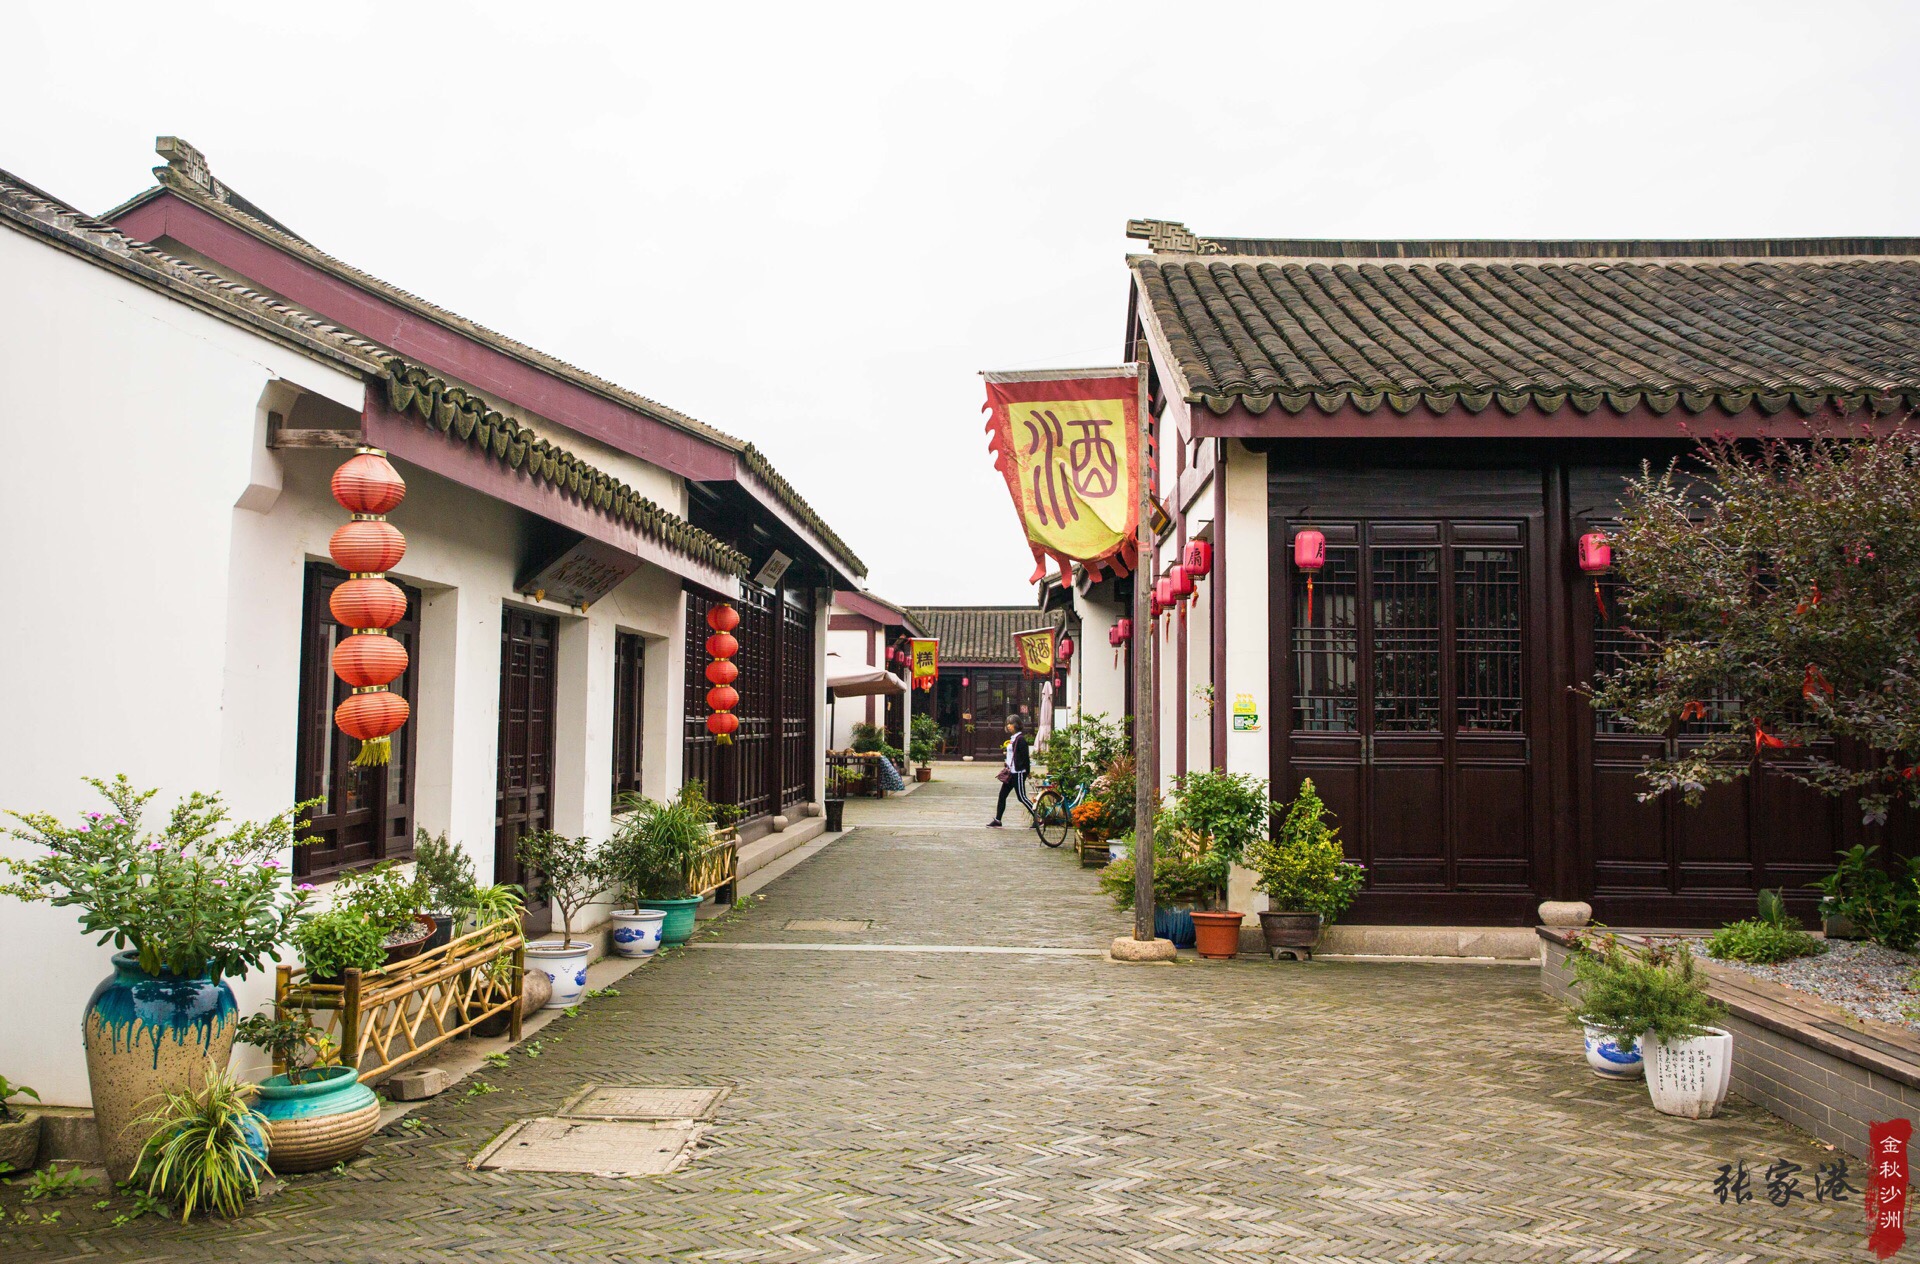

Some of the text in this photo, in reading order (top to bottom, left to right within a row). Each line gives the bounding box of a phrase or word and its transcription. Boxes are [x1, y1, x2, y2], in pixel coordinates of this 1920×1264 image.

[1023, 409, 1118, 530] 酒
[916, 651, 933, 668] 糕
[1026, 637, 1050, 666] 酒
